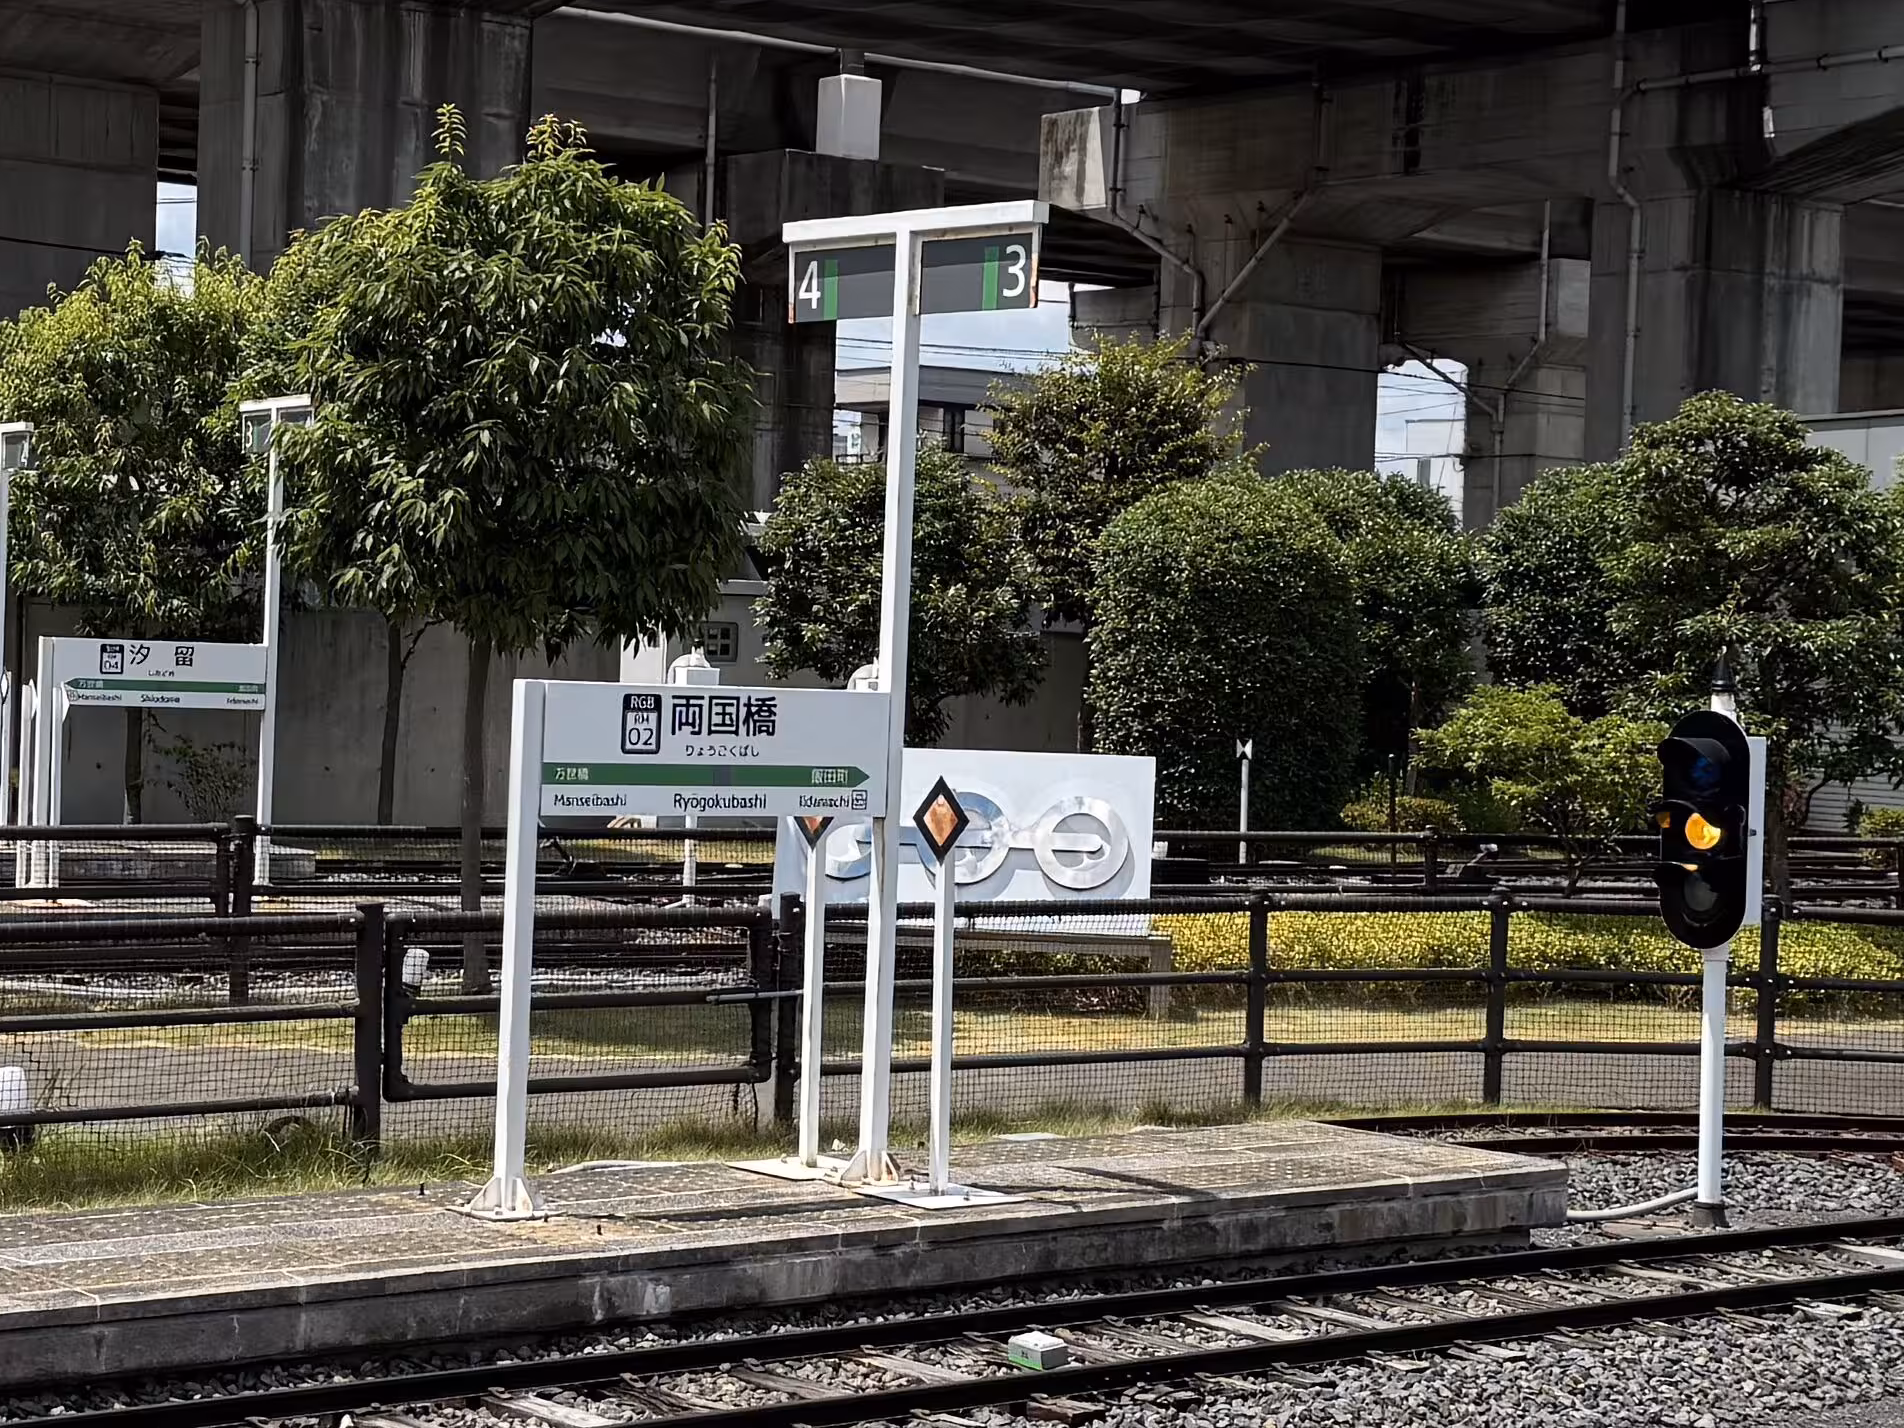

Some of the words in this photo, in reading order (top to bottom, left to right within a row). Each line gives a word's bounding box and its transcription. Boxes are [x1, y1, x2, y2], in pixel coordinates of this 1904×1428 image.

[798, 260, 821, 310] 4
[1002, 244, 1027, 298] 3
[630, 695, 655, 710] RGB
[670, 695, 778, 737] 両国橋
[627, 727, 655, 747] 02
